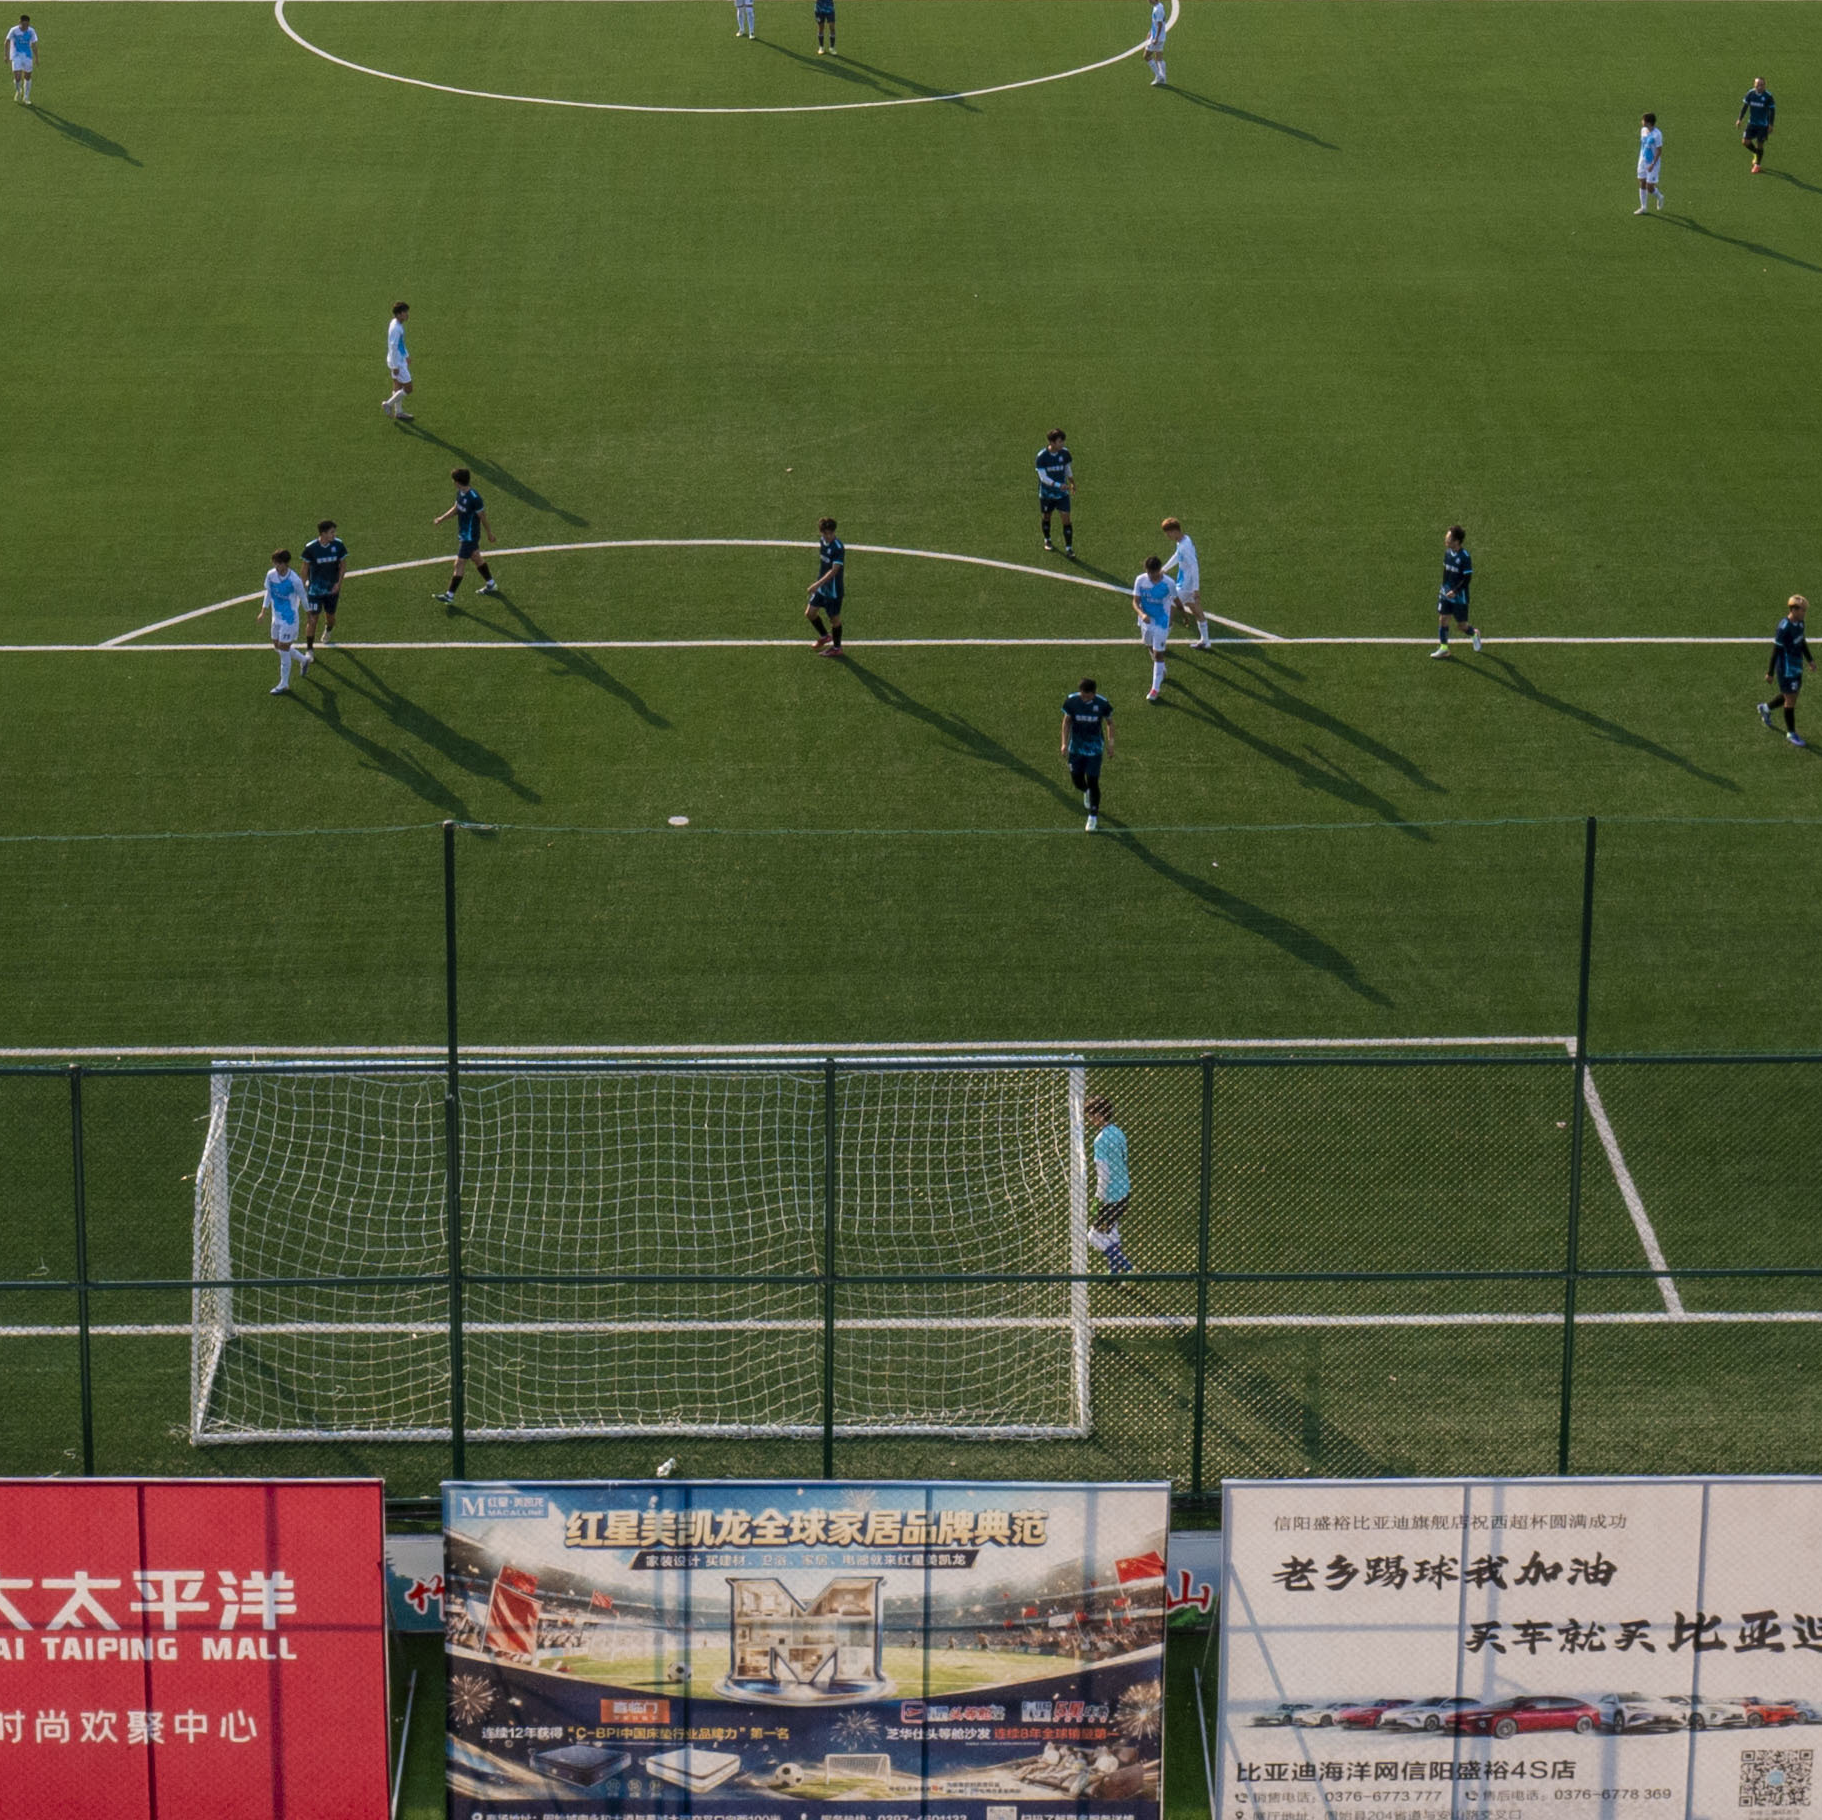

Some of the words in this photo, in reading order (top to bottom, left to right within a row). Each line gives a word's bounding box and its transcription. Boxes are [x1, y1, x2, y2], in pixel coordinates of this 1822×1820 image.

[566, 1509, 1048, 1547] 红星美凯龙全球家居品牌典范
[1274, 1514, 1627, 1531] 信阳盛裕比亚迪旗舰店祝西超杯圆满成功
[1272, 1551, 1618, 1592] 老乡踢球我加油
[41, 1636, 177, 1662] TAIPING
[202, 1636, 297, 1660] MALL
[1236, 1759, 1577, 1782] 比亚迪海洋网信阳盛裕4S店
